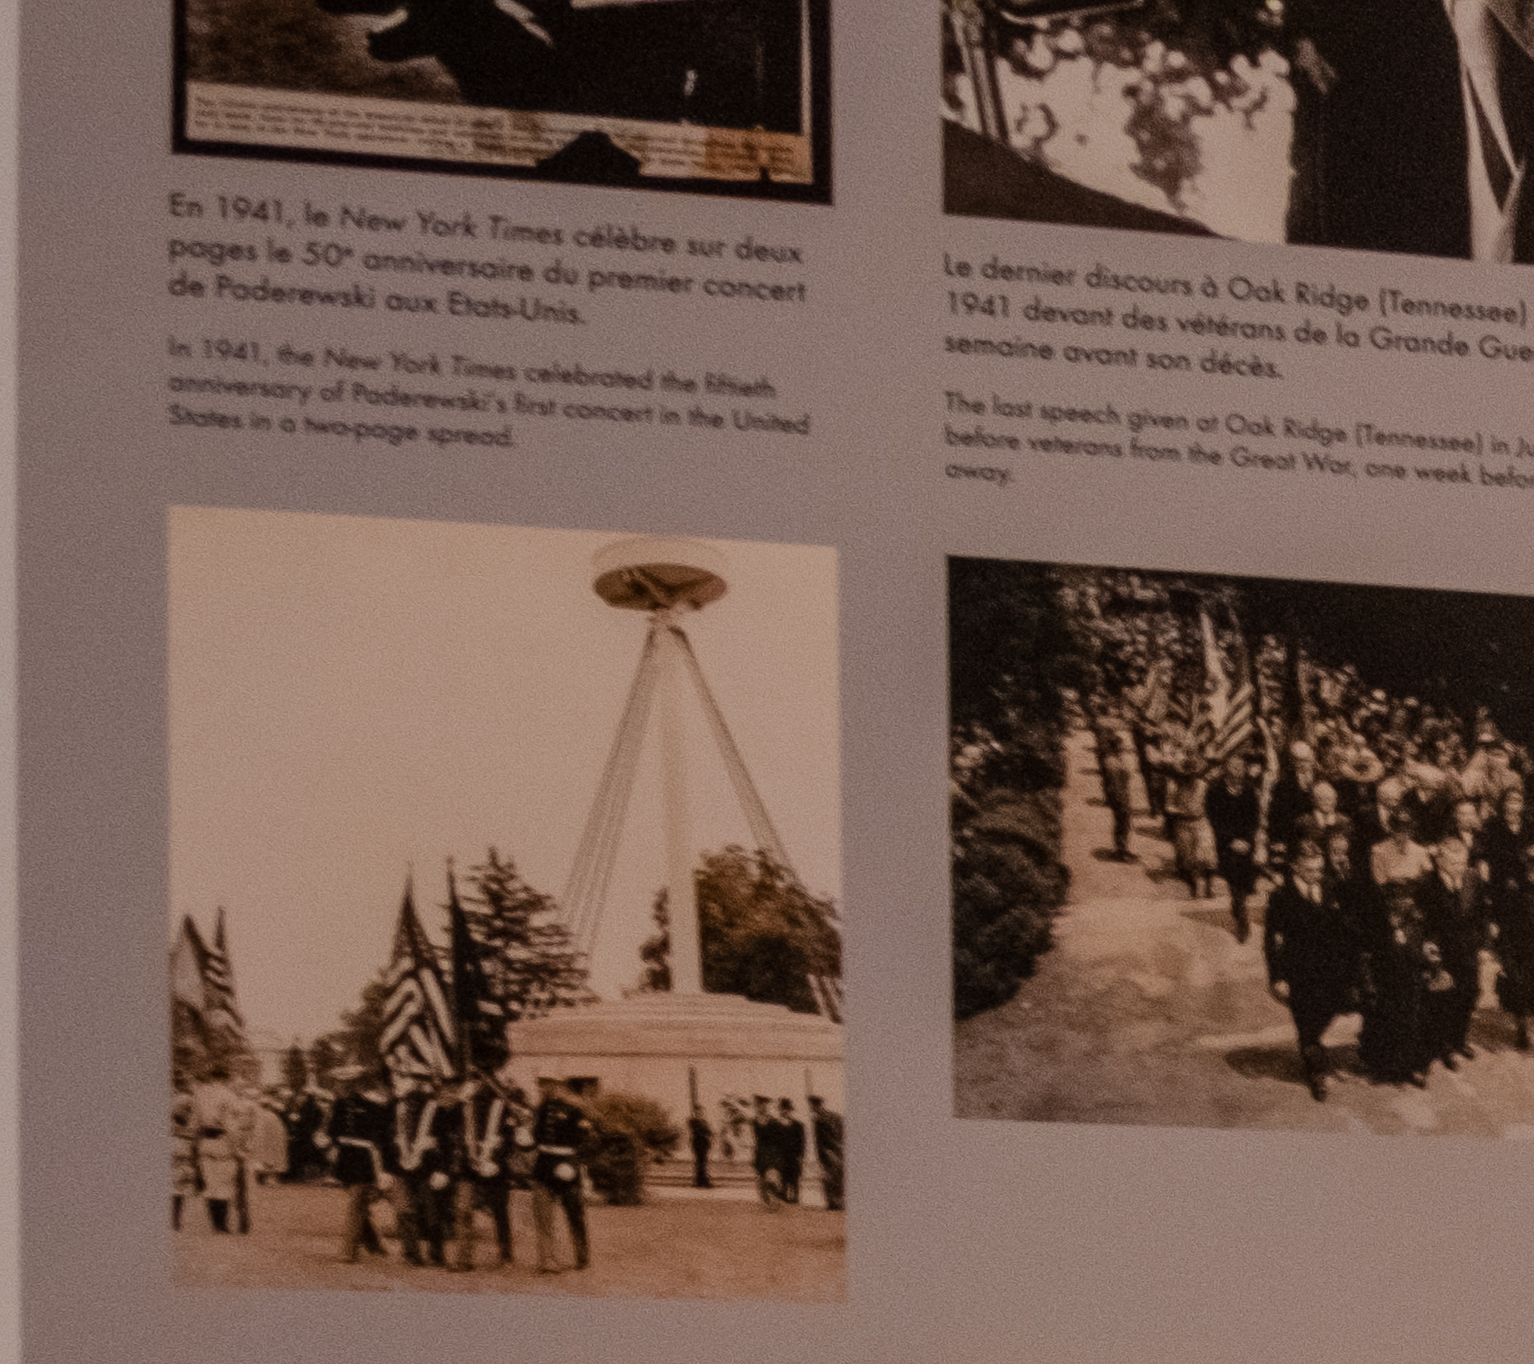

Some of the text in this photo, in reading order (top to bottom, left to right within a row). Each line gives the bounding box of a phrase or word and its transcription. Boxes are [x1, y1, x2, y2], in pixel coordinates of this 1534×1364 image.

[168, 191, 204, 218] En
[304, 202, 330, 228] le
[339, 205, 407, 232] New
[417, 211, 477, 238] York
[488, 214, 564, 246] Times
[572, 224, 677, 255] célèbre
[686, 239, 726, 258] sur
[734, 235, 802, 264] deux
[167, 270, 206, 298] de
[215, 273, 376, 309] Paderewski
[384, 293, 437, 313] aux
[168, 238, 258, 268] pages
[266, 238, 293, 264] le
[362, 253, 535, 283] anniversaire
[542, 259, 579, 287] du
[587, 269, 694, 294] premier
[702, 279, 807, 302] concert
[943, 253, 973, 279] Le
[980, 255, 1076, 287] dernier
[1084, 263, 1194, 297] discours
[1200, 275, 1219, 300] à
[1227, 275, 1286, 304] Oak
[1295, 281, 1370, 317] Ridge
[1379, 288, 1527, 327] (Tennessee)
[944, 336, 1055, 362] semaine
[1063, 345, 1138, 366] avant
[1146, 352, 1191, 371] son
[948, 290, 1009, 318] 1941
[1022, 296, 1114, 327] devant
[1121, 305, 1169, 333] des
[1176, 313, 1287, 342] vétérans
[1293, 319, 1328, 345] de
[1336, 322, 1361, 349] la
[1368, 325, 1470, 358] Grande
